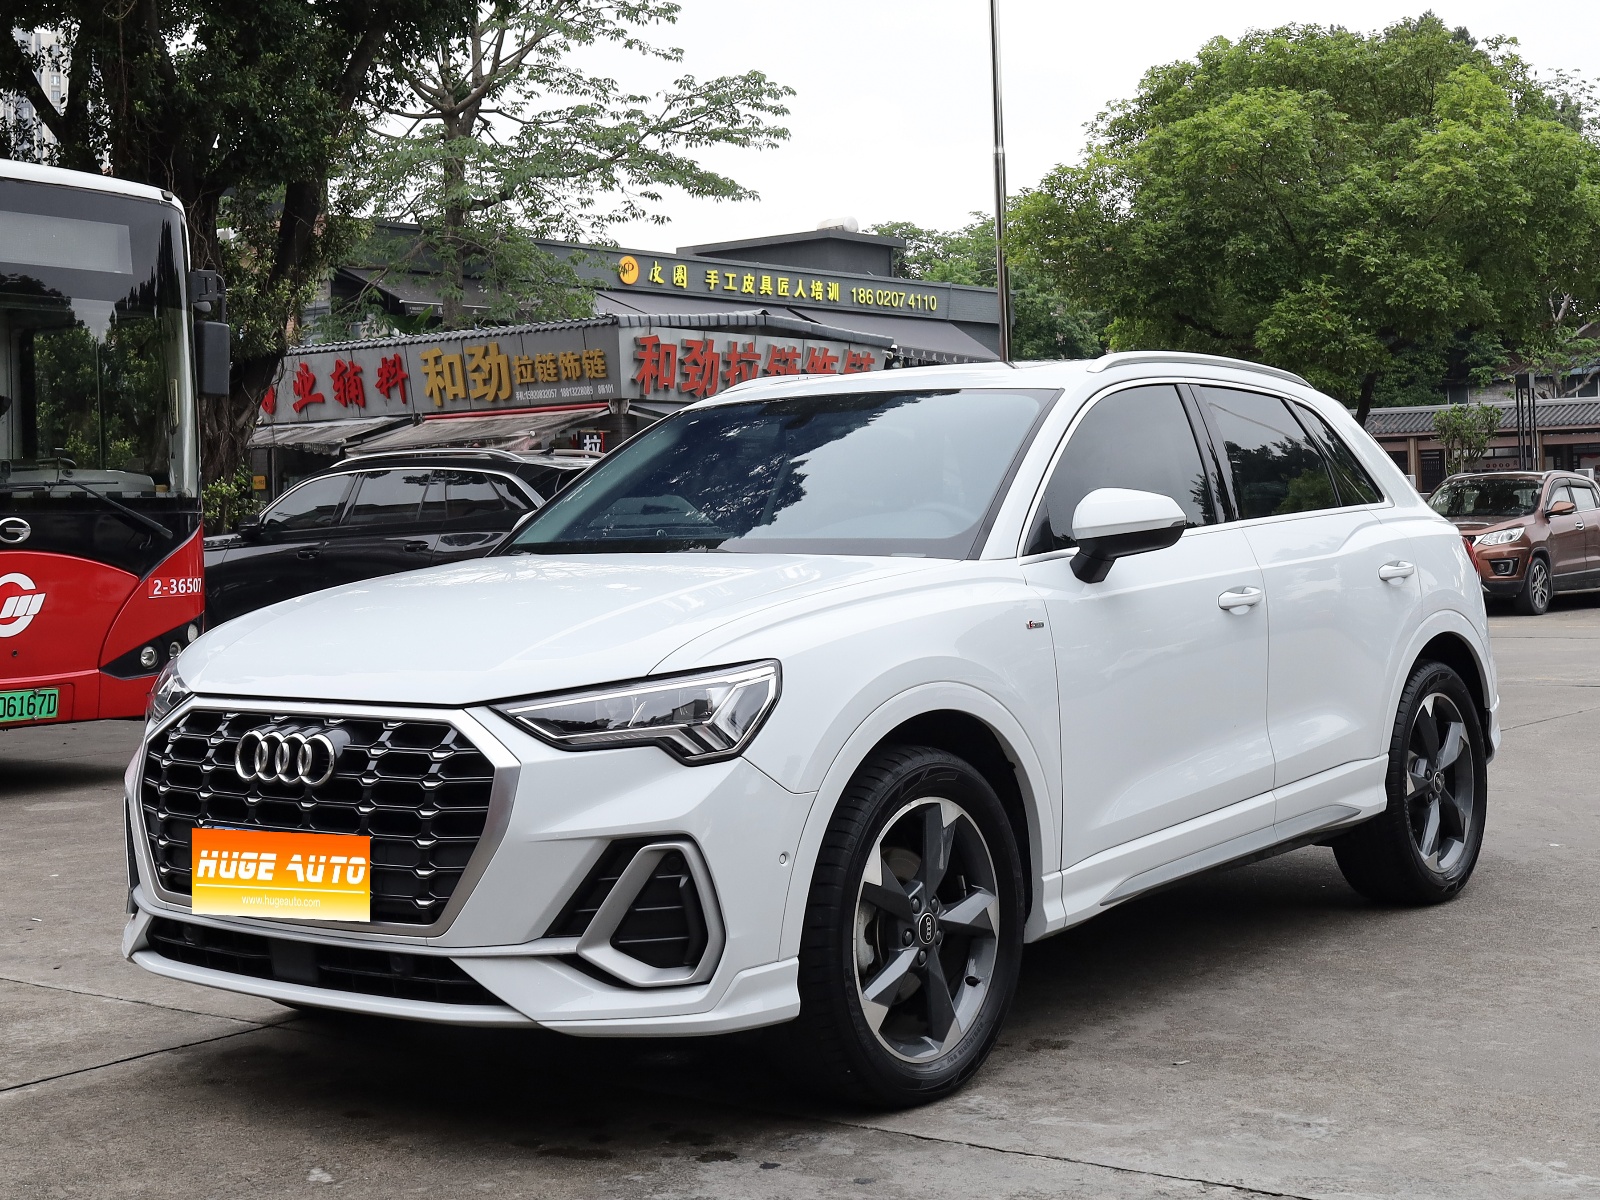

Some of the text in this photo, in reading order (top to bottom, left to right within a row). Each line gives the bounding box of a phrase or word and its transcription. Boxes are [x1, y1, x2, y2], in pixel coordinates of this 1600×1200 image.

[705, 269, 840, 302] 手工皮具匠人培训
[261, 353, 408, 415] 业辅料
[419, 341, 607, 407] 和劲 拉链饰链
[153, 577, 202, 595] 2-36507
